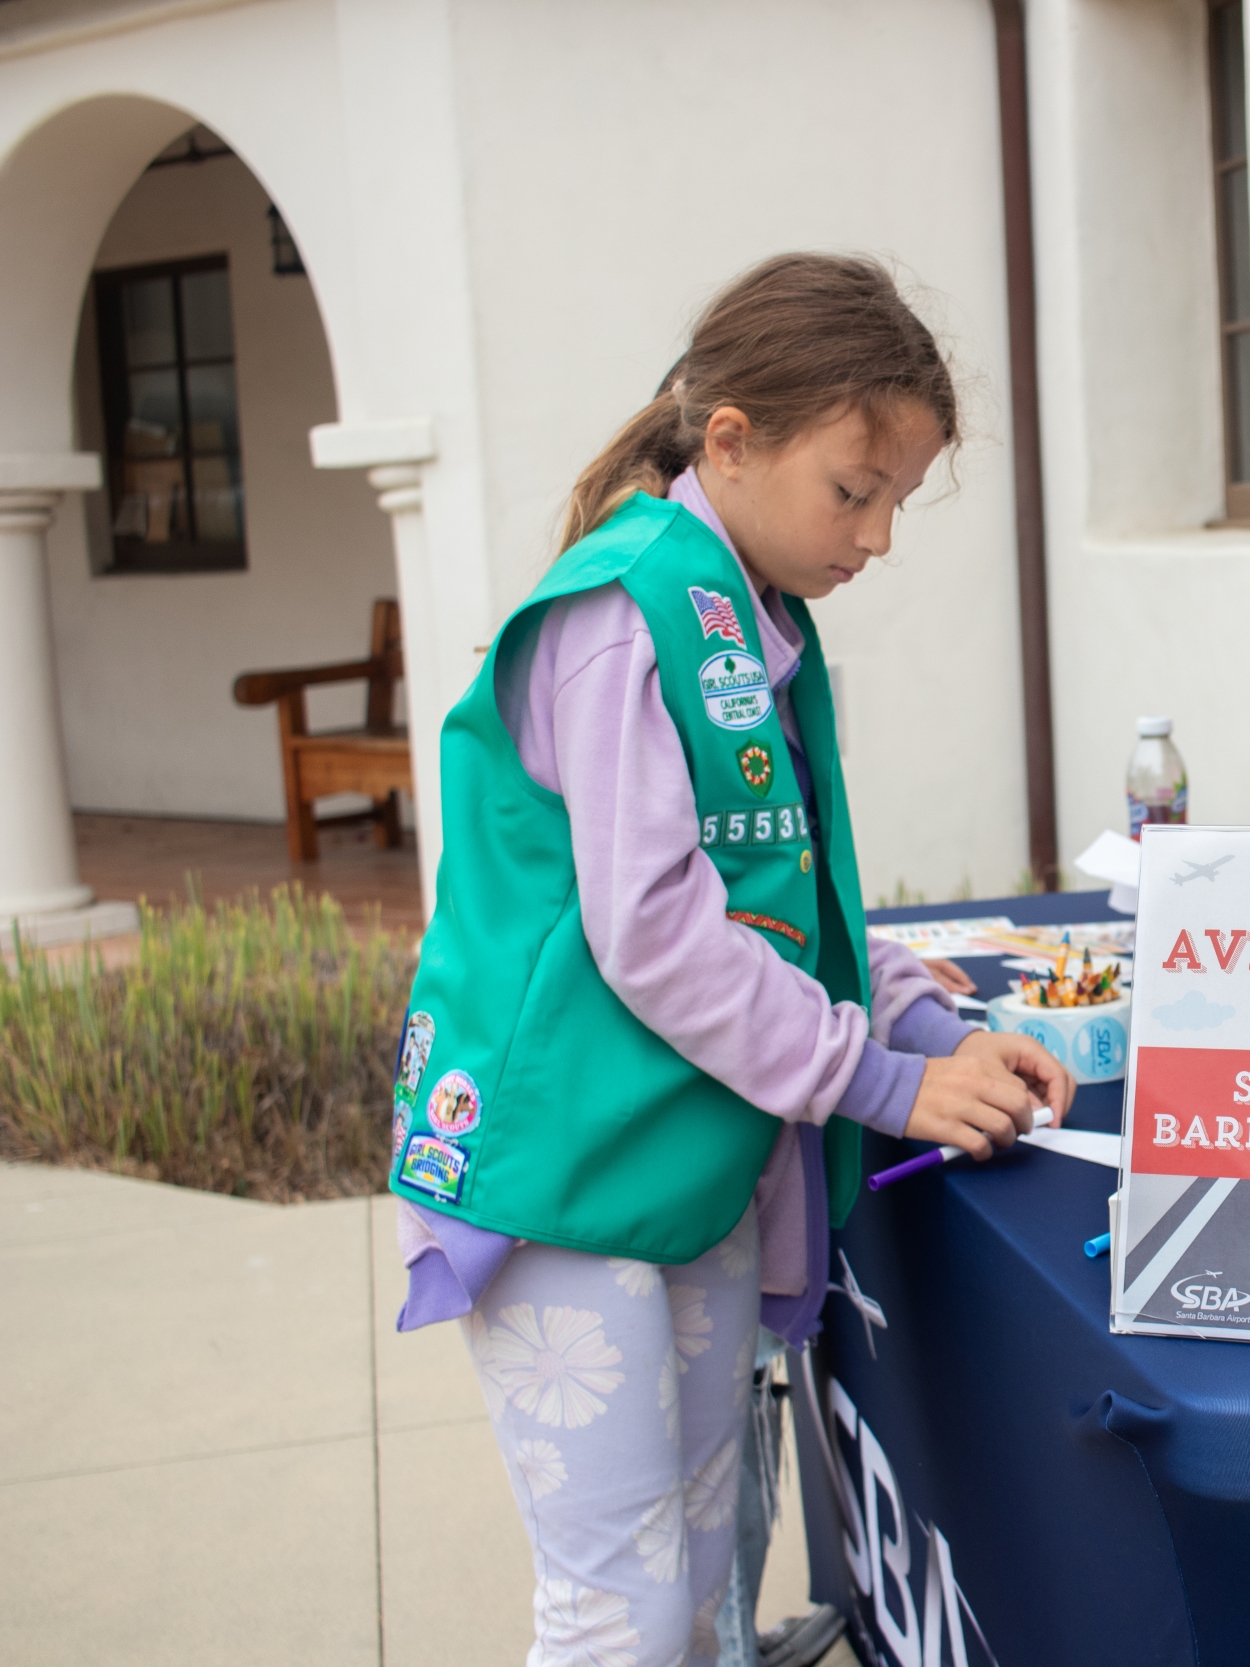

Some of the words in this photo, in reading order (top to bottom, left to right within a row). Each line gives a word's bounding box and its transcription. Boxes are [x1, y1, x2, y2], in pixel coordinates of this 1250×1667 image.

[704, 677, 718, 690] GIRL
[719, 672, 750, 688] SCOUTS
[751, 670, 765, 684] USA
[723, 709, 746, 722] CENTRAL
[746, 705, 762, 718] COAST
[410, 1144, 425, 1158] GIRL
[427, 1146, 460, 1174] SCOUTS
[411, 1157, 450, 1183] BRIDGING
[1181, 1285, 1240, 1312] SBA
[1176, 1310, 1196, 1320] Santa
[1197, 1311, 1225, 1322] Barbara
[1226, 1314, 1250, 1324] Airport
